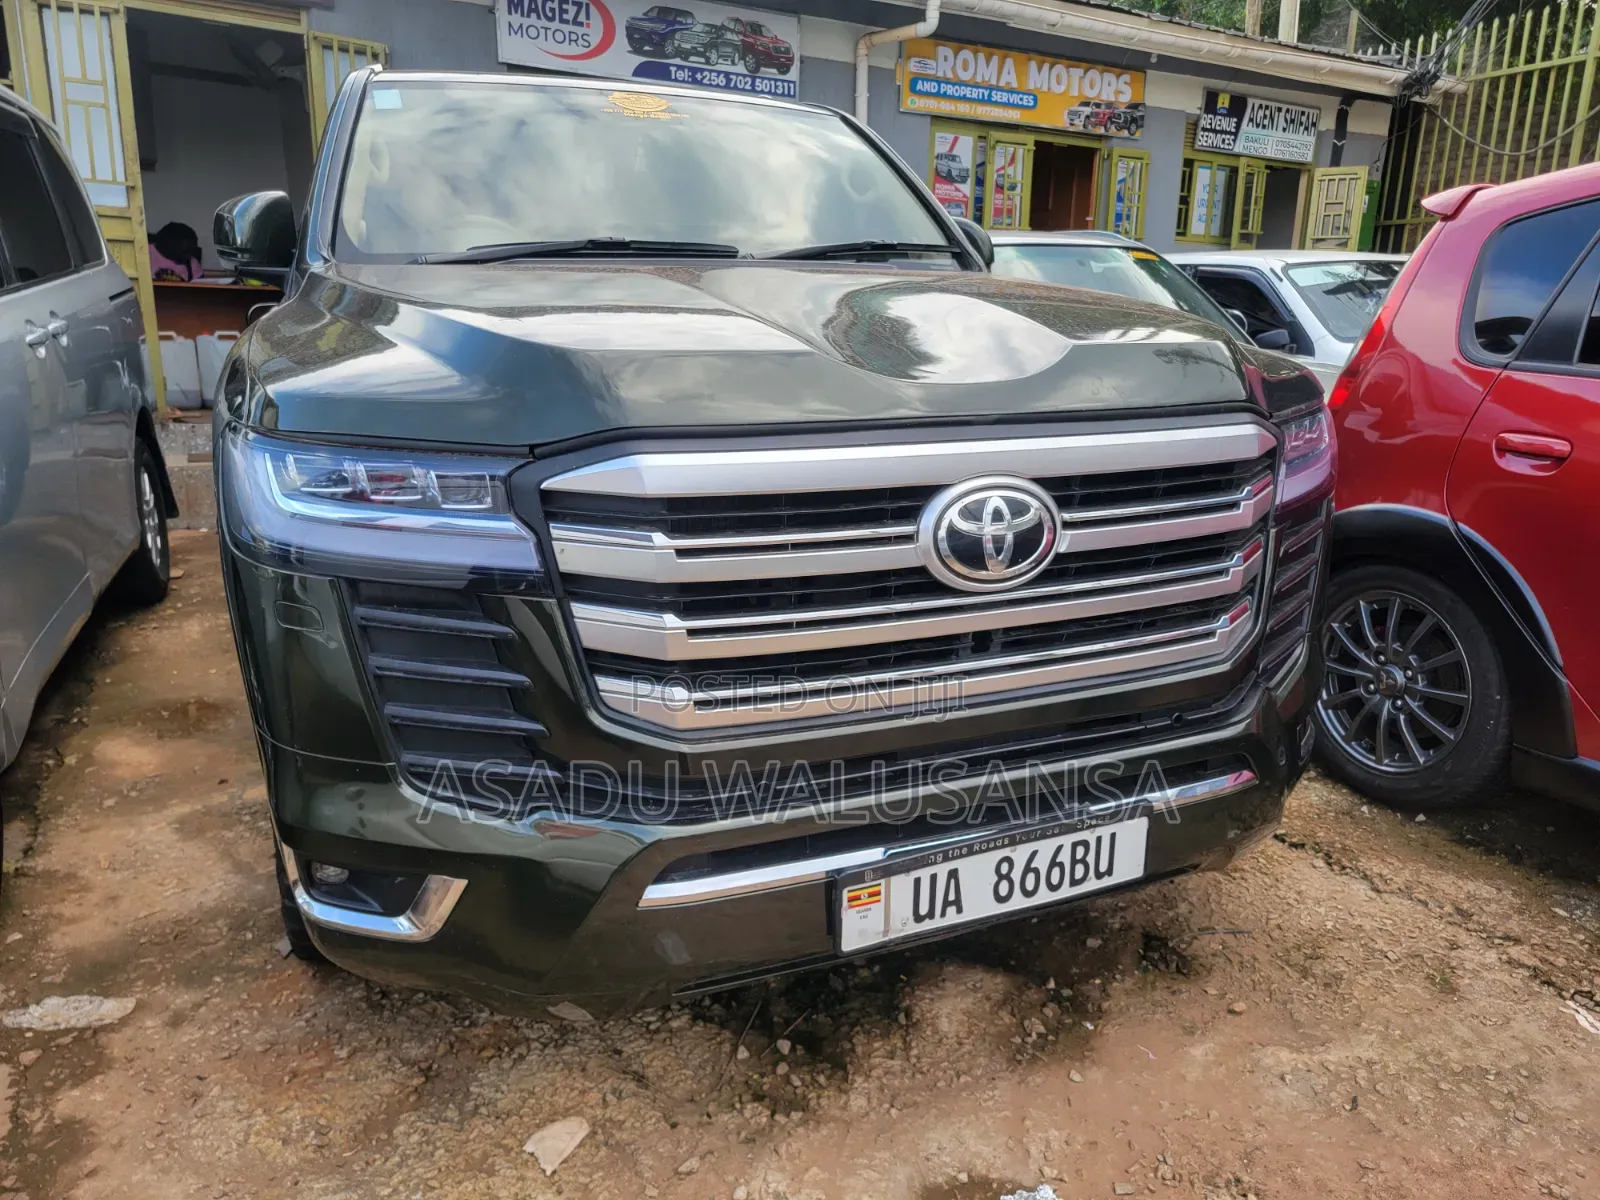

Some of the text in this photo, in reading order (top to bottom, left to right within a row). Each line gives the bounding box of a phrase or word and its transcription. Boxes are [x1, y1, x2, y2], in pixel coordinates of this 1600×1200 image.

[508, 21, 591, 49] MOTORS
[669, 66, 795, 96] Tel: +256 702 501311
[936, 46, 1132, 103] ROMA MOTORS
[916, 80, 1034, 106] AND PROPERTY SERVICES
[1202, 114, 1237, 132] REVENUE
[1247, 102, 1318, 137] AGENT SHIFAH
[1198, 132, 1235, 150] SERVICES
[1244, 135, 1269, 147] BAKULI
[949, 846, 968, 858] the
[973, 836, 1009, 852] Roads
[911, 831, 1117, 924] UA 866BU
